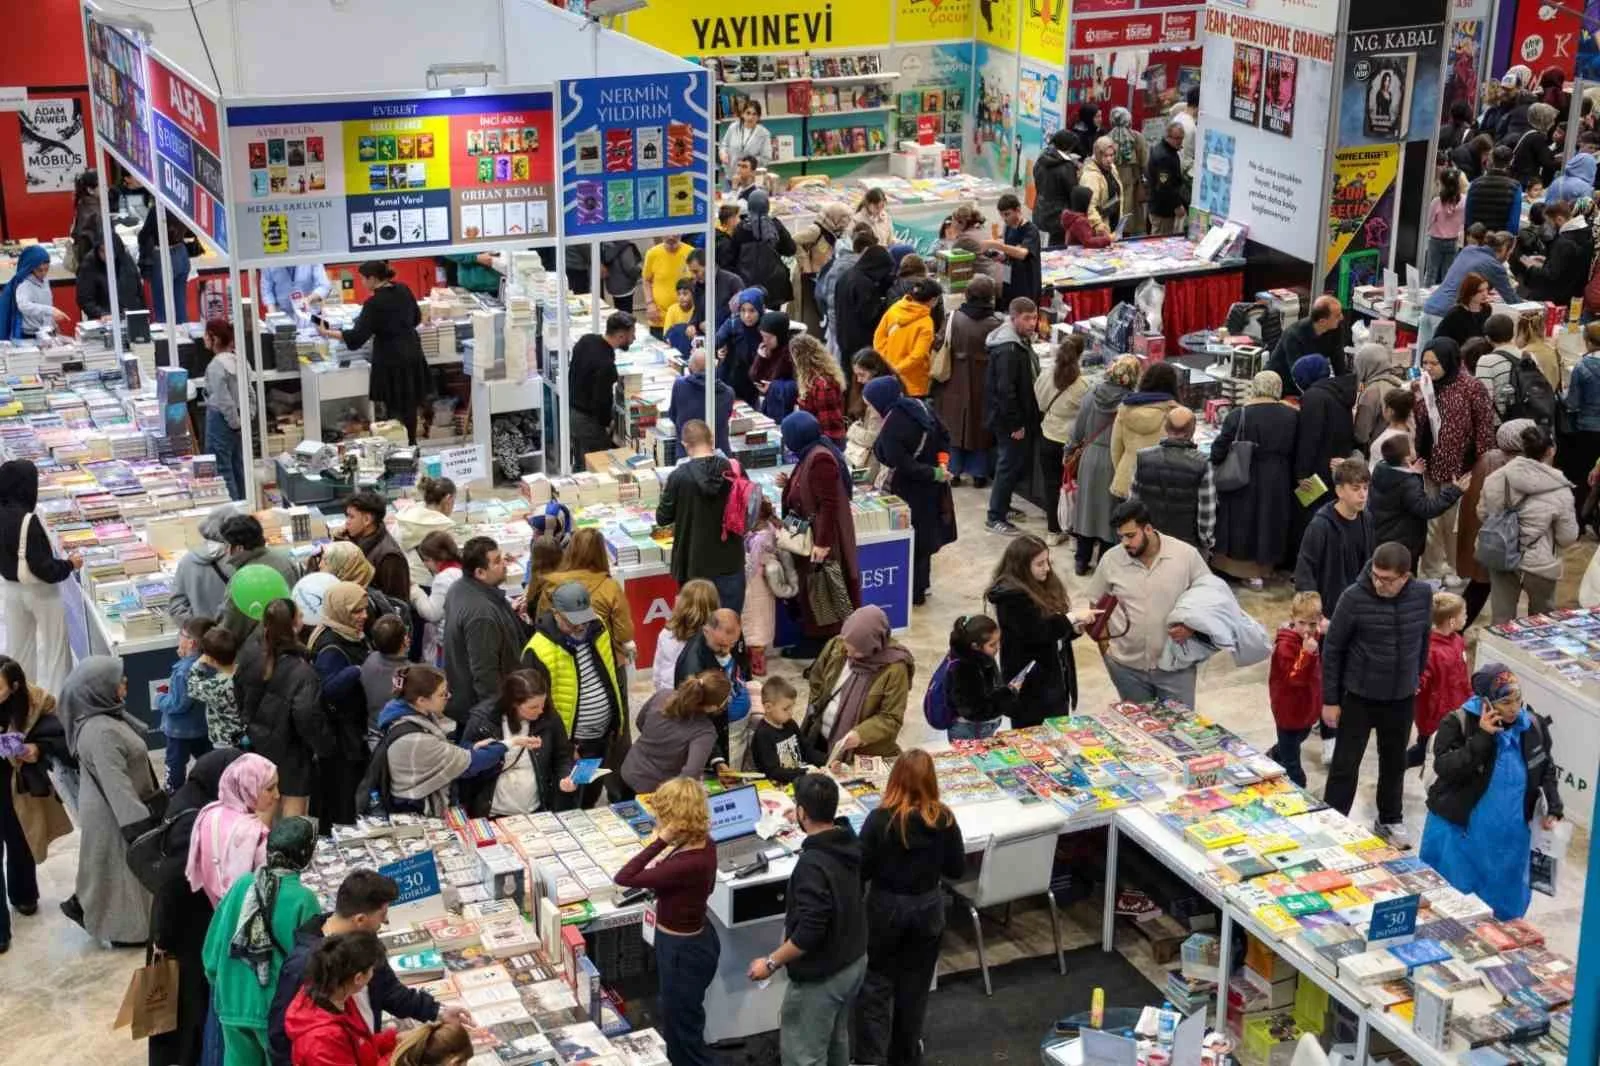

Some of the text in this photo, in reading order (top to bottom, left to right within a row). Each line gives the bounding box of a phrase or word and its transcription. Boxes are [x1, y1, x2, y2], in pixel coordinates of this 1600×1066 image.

[692, 4, 832, 50] YAYINEVİ
[1205, 8, 1291, 50] JEAN-CHRISTOPHE
[1353, 30, 1436, 52] N.G. KABAL
[169, 76, 206, 132] ALFA
[600, 83, 668, 105] NERMİN
[34, 116, 68, 124] FAWER
[35, 107, 65, 115] ADAM
[597, 102, 672, 122] YILDIRIM
[374, 195, 424, 207] Kemal Varol
[462, 186, 546, 201] ORHAN KEMAL
